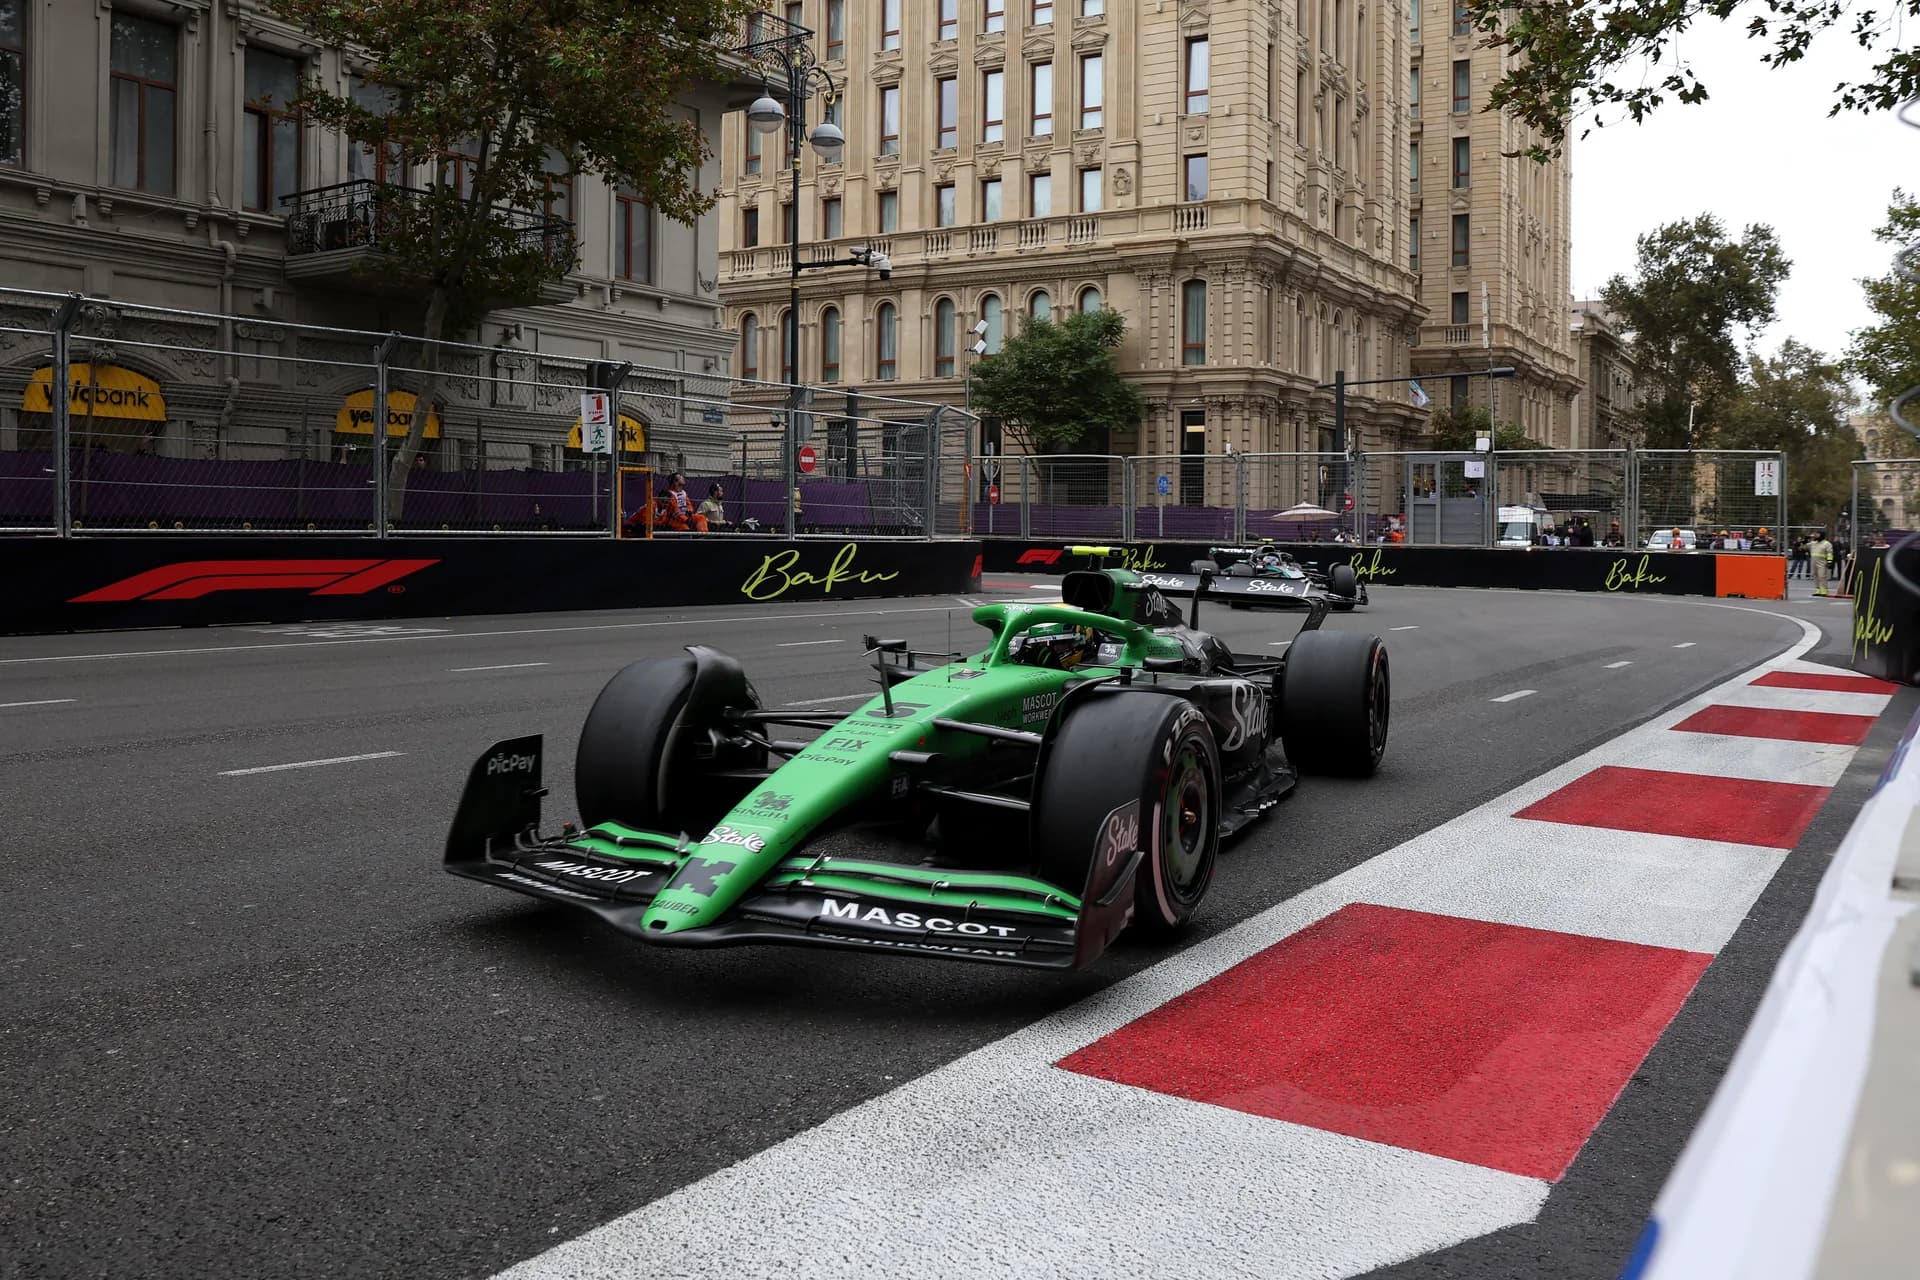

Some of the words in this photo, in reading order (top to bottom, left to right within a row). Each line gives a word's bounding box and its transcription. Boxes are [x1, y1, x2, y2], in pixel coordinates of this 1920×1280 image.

[1122, 544, 1167, 573] Baku
[1350, 548, 1397, 581] Baku
[741, 542, 899, 600] Baku
[1140, 574, 1186, 588] Stake
[1605, 554, 1667, 591] Baku
[1247, 579, 1295, 594] Stake
[1023, 692, 1057, 712] MASCOT
[1221, 680, 1269, 752] Stake
[826, 737, 873, 750] FIX
[487, 753, 536, 776] PicPay
[731, 808, 790, 821] SINGHA
[699, 826, 766, 853] Stake
[1107, 815, 1138, 867] Stake
[534, 860, 654, 884] MASCOT
[648, 900, 700, 917] SAUBER
[820, 898, 1017, 937] MASCOT
[816, 933, 1017, 957] WORKWEAR
